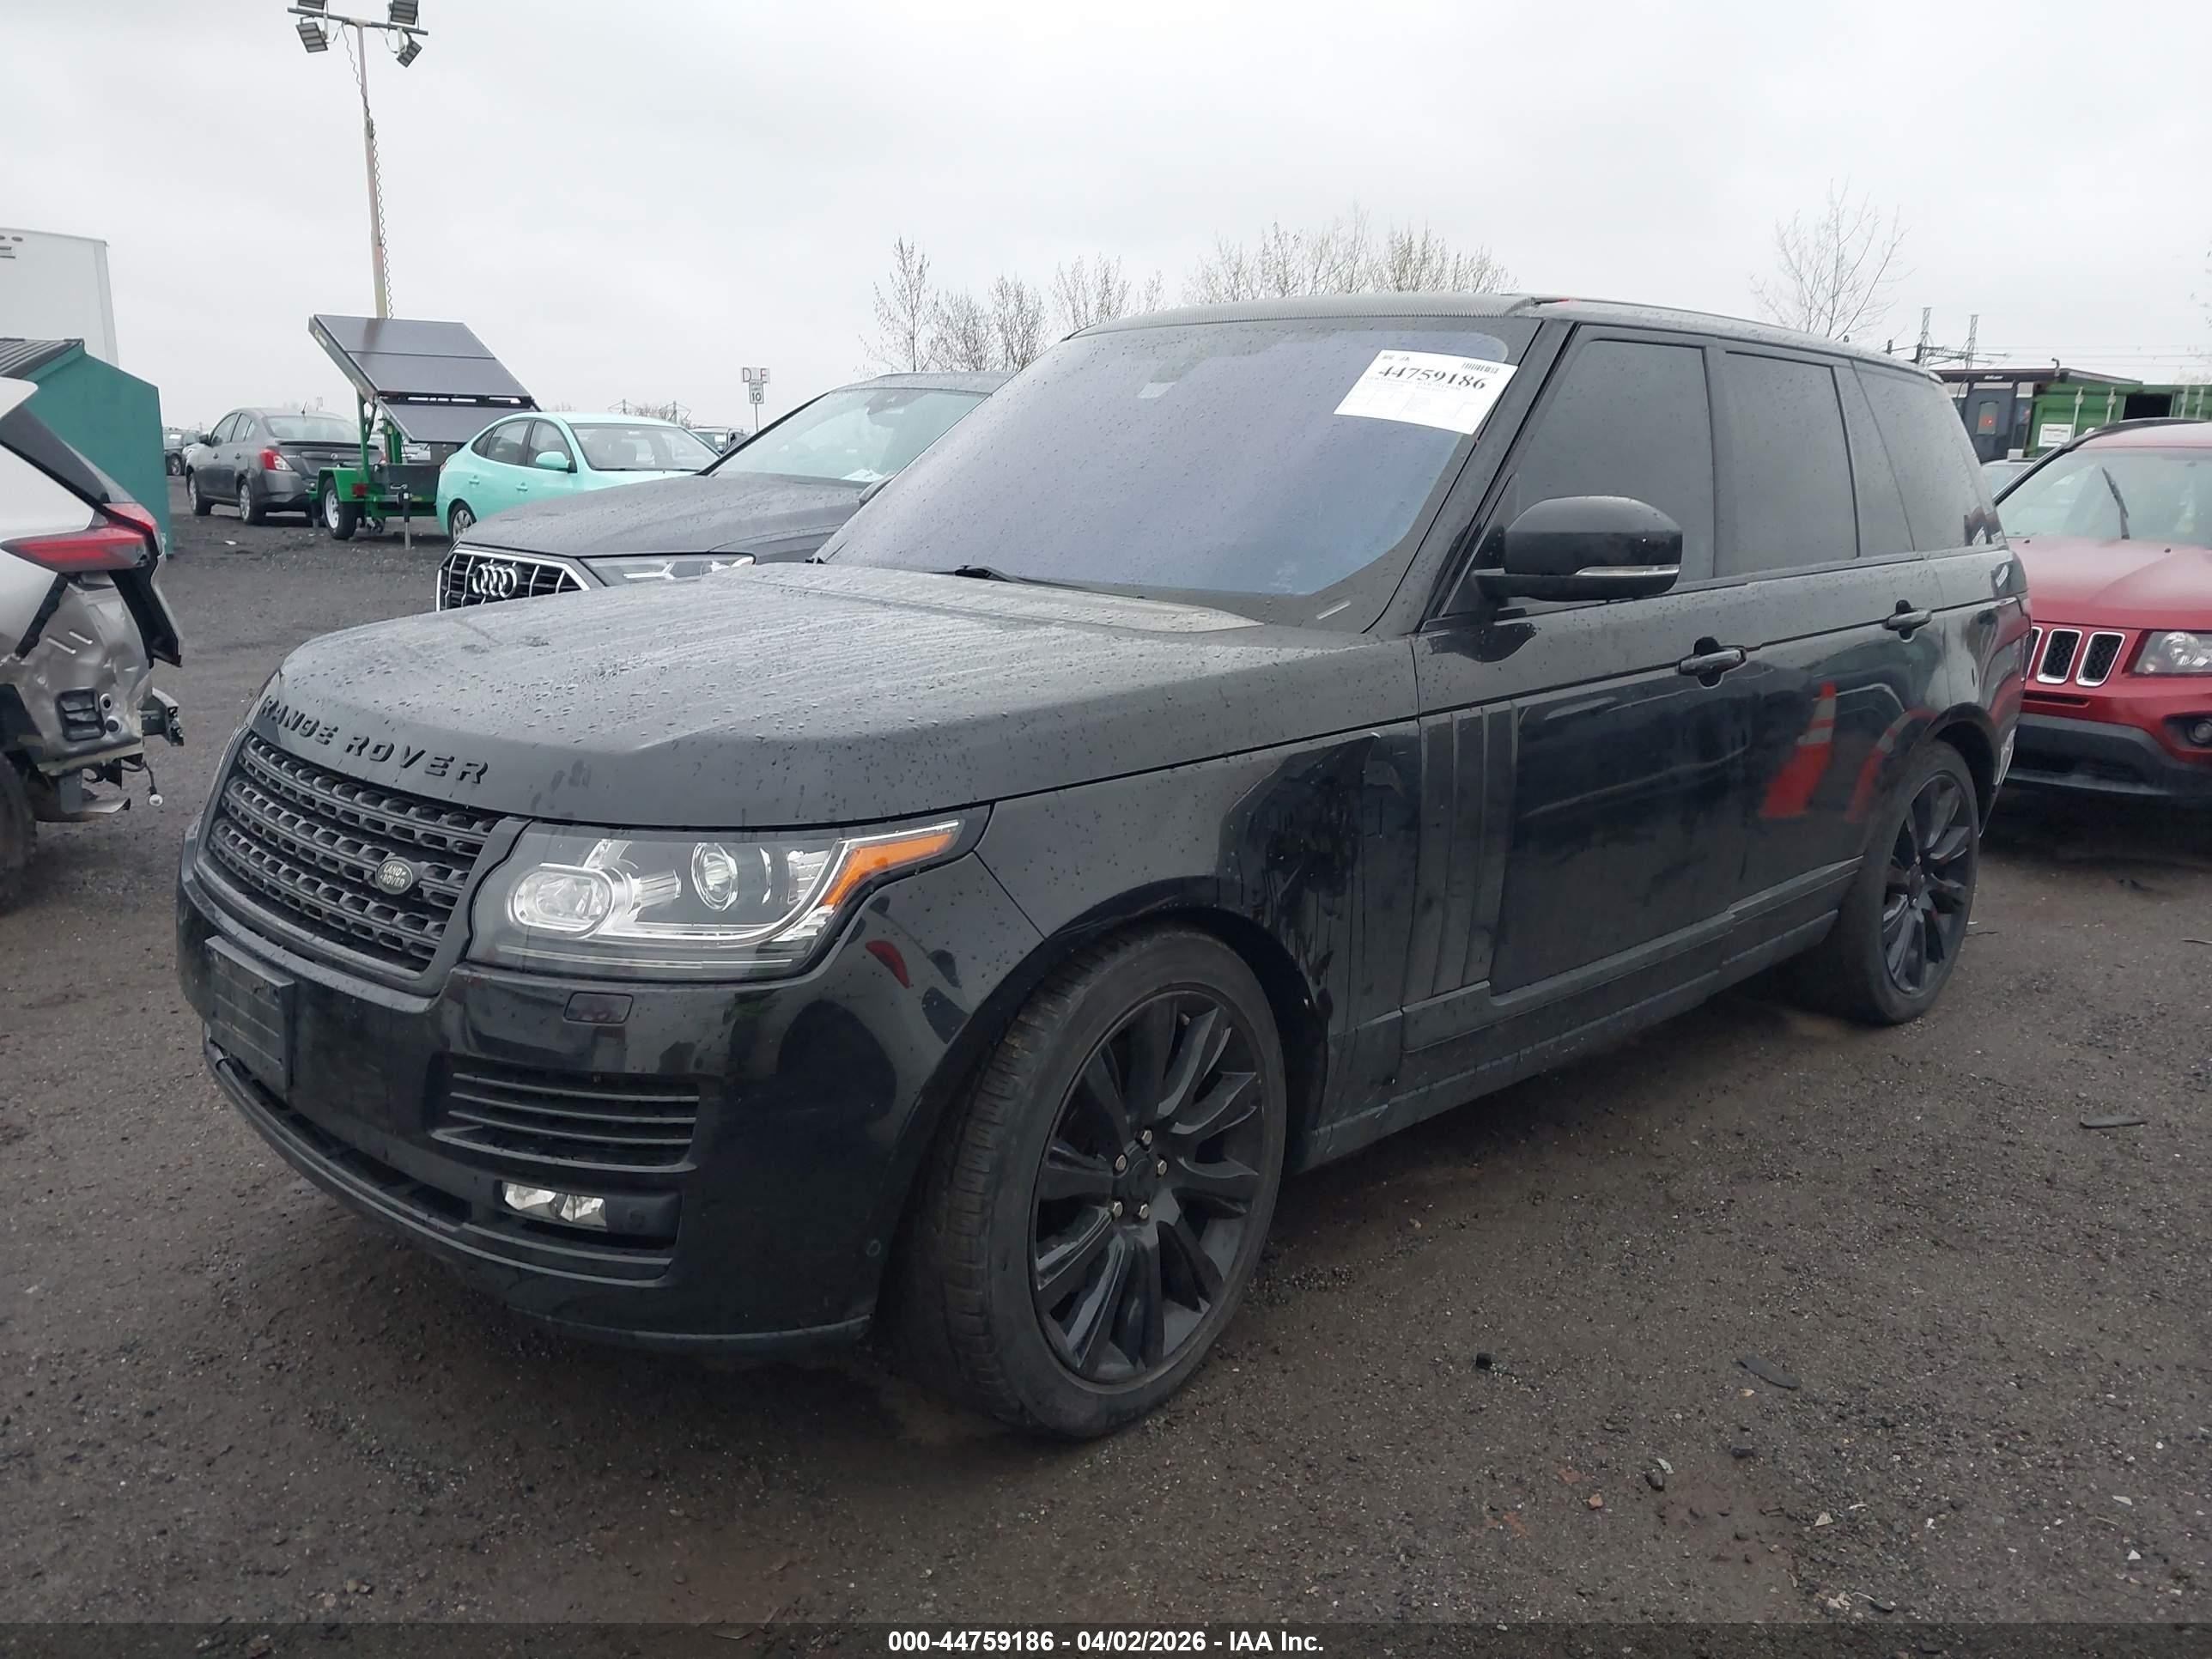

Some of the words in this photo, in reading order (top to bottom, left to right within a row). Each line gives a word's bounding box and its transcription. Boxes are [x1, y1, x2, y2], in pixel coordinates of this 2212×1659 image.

[1378, 366, 1488, 390] 44759186
[752, 392, 762, 402] 10
[260, 695, 338, 745] RANGE
[345, 736, 489, 785] ROVER
[383, 864, 403, 876] LAND
[382, 873, 405, 888] ROVER
